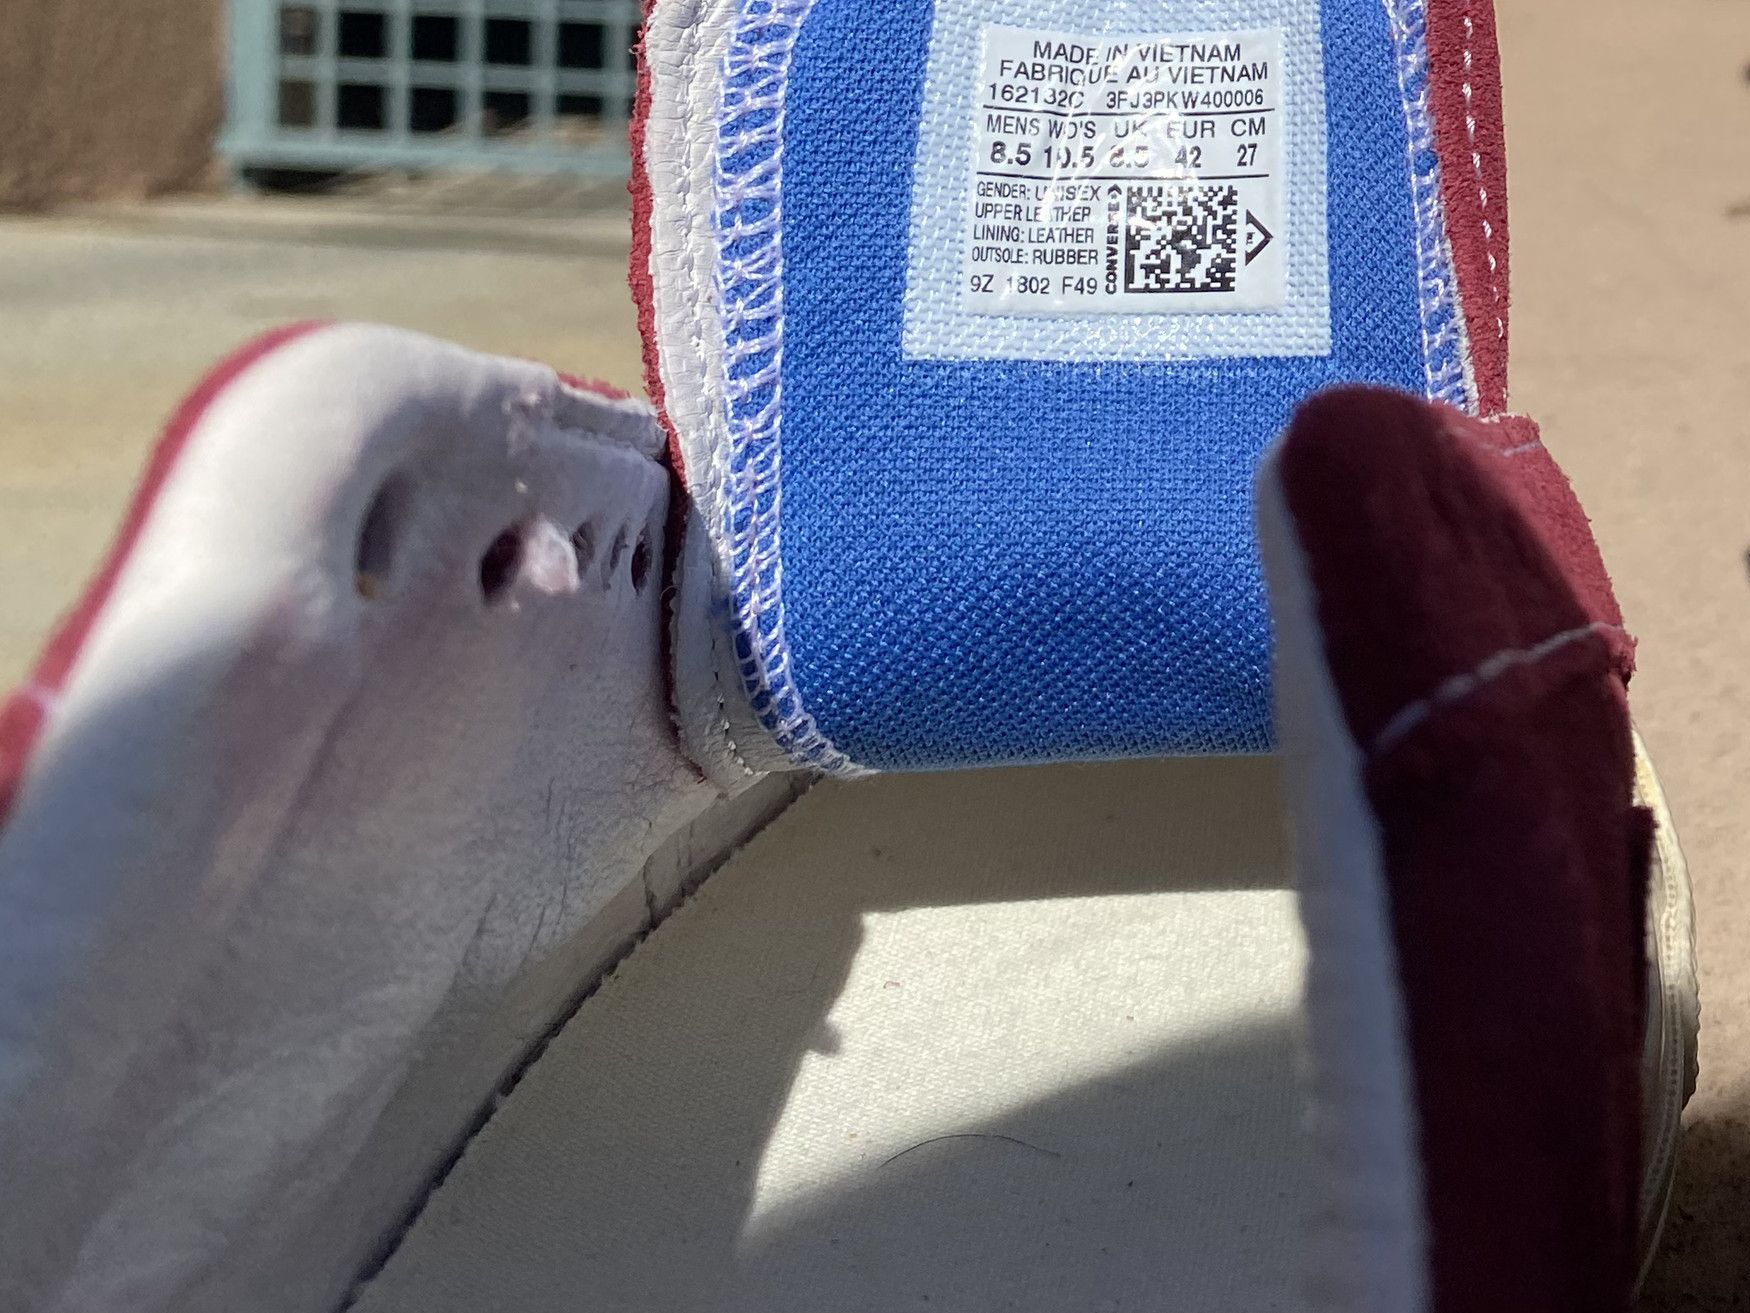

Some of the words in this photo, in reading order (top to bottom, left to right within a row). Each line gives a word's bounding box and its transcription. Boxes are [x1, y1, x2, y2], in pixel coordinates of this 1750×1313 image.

[1033, 40, 1099, 65] MADE
[1106, 43, 1128, 62] IN
[1137, 43, 1241, 63] VIETNAM
[1000, 60, 1119, 86] FABRIQUE
[1127, 66, 1159, 84] AU
[1168, 62, 1268, 84] VIETNAM
[989, 83, 1084, 108] 162132C
[986, 114, 1040, 136] MENS
[1114, 121, 1149, 138] UK
[1166, 120, 1216, 138] EUR
[1230, 117, 1266, 136] CM
[990, 141, 1031, 166] 8.5
[1044, 145, 1095, 168] 10.5
[1175, 145, 1201, 168] 42
[1237, 143, 1258, 167] 27
[977, 181, 1030, 201] GENDER:
[1026, 206, 1091, 223] LETHER
[973, 225, 1025, 243] LINING:
[1028, 226, 1094, 244] LEATHER
[972, 246, 1029, 264] OUTSOLE:
[1033, 248, 1098, 265] RUBBER
[970, 275, 994, 293] 9Z
[1062, 276, 1098, 296] F49
